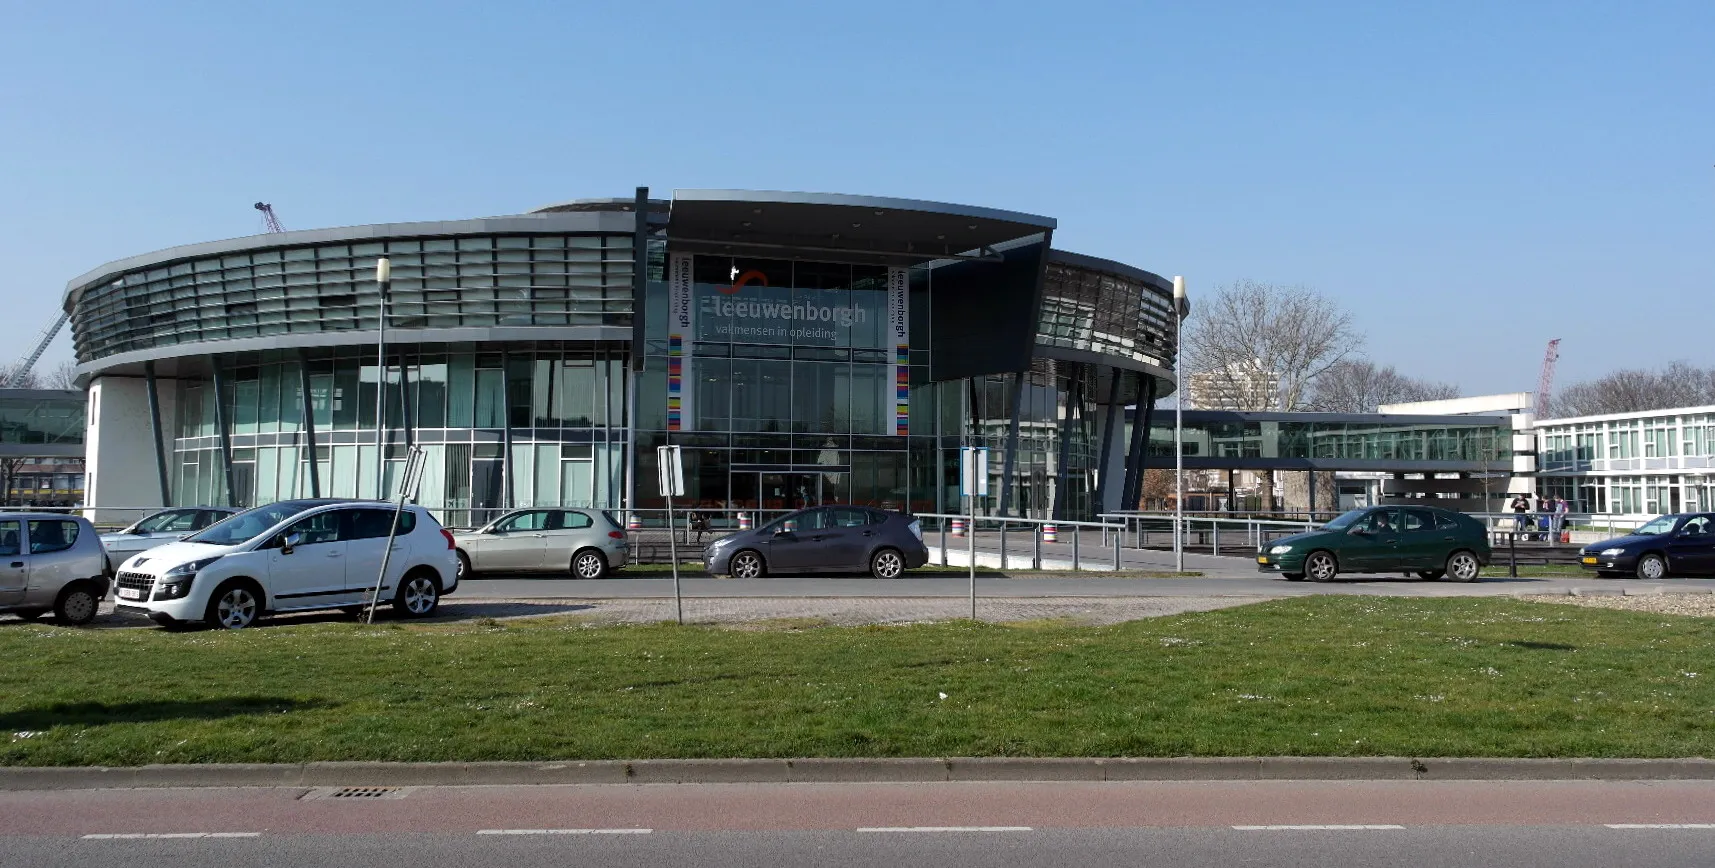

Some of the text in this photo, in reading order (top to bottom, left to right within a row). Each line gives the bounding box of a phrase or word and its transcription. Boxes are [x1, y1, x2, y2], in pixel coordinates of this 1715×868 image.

[679, 257, 691, 328] leeuwenborgh
[712, 296, 866, 327] leeuwenborgh
[896, 270, 906, 337] leeuwenborgh
[716, 324, 837, 341] vakmensen in opleiding
